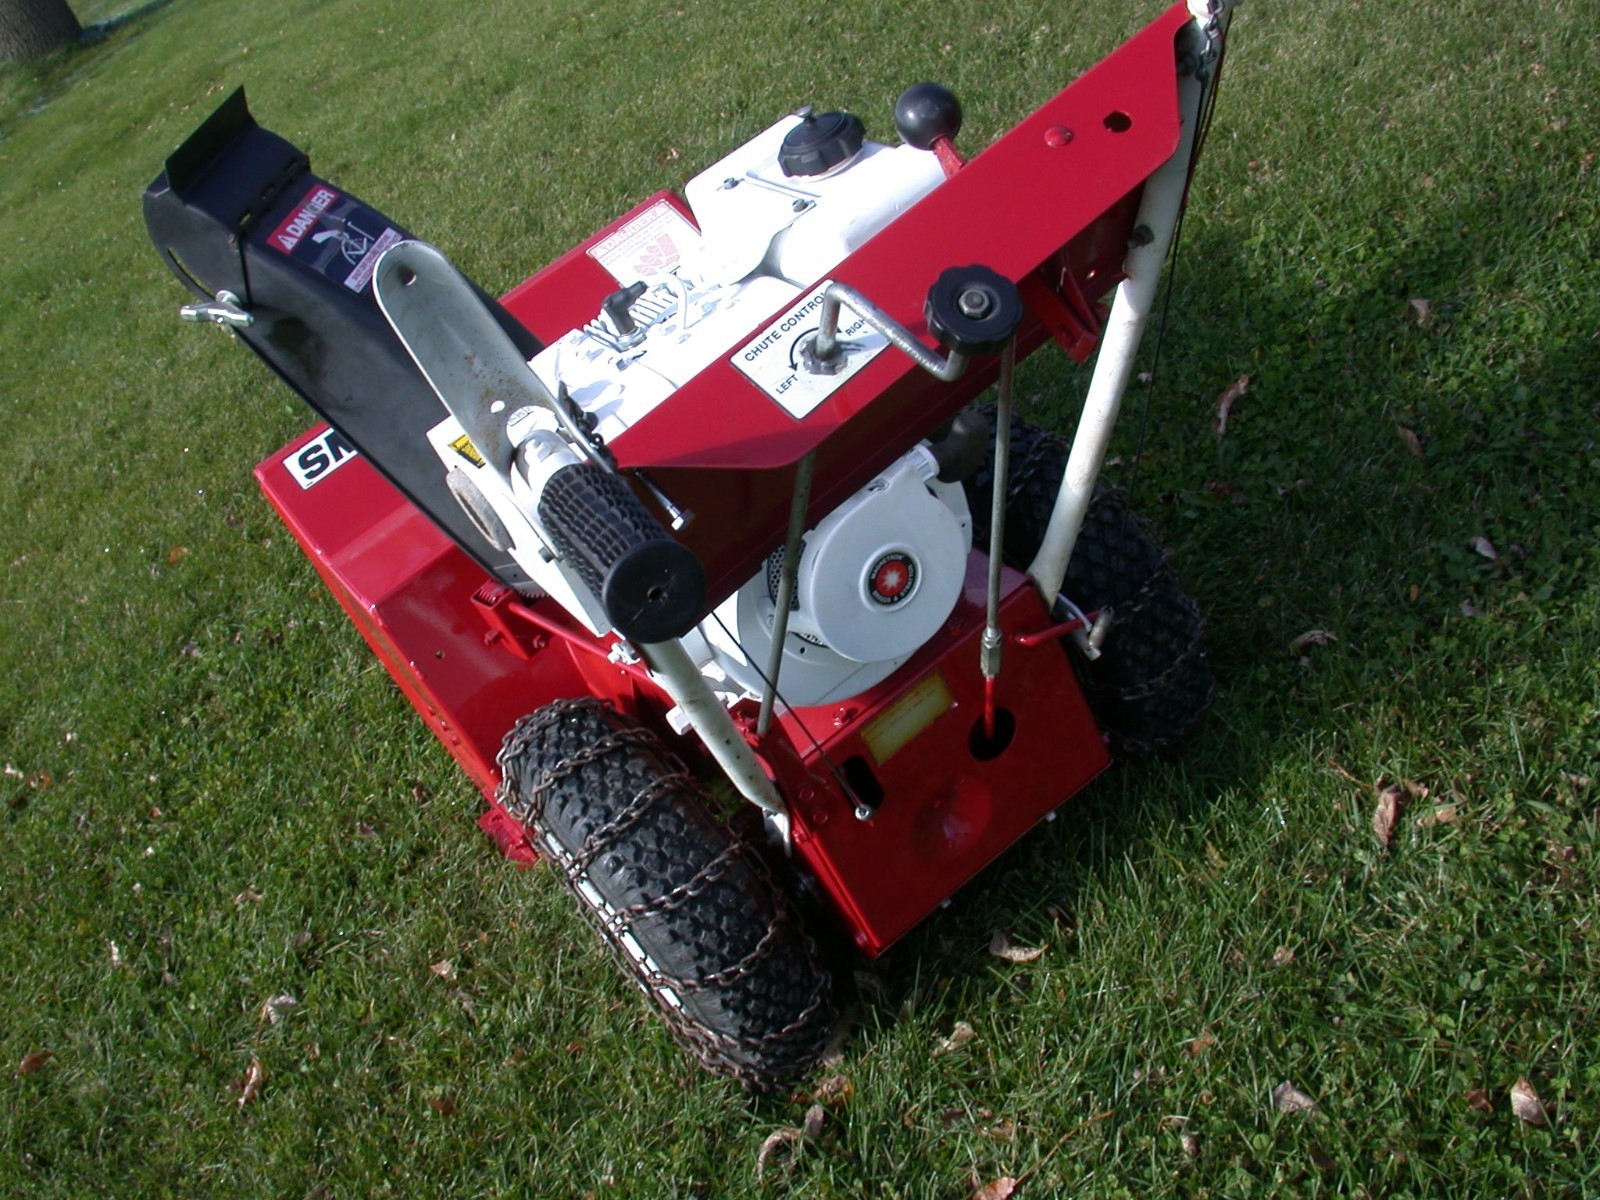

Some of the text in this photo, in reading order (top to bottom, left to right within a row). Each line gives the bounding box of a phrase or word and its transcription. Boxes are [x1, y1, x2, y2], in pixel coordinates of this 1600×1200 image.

[286, 189, 335, 237] DANGER
[744, 292, 825, 362] CHUTE CONTRO
[845, 318, 865, 336] RIGH
[776, 374, 798, 395] LEFT
